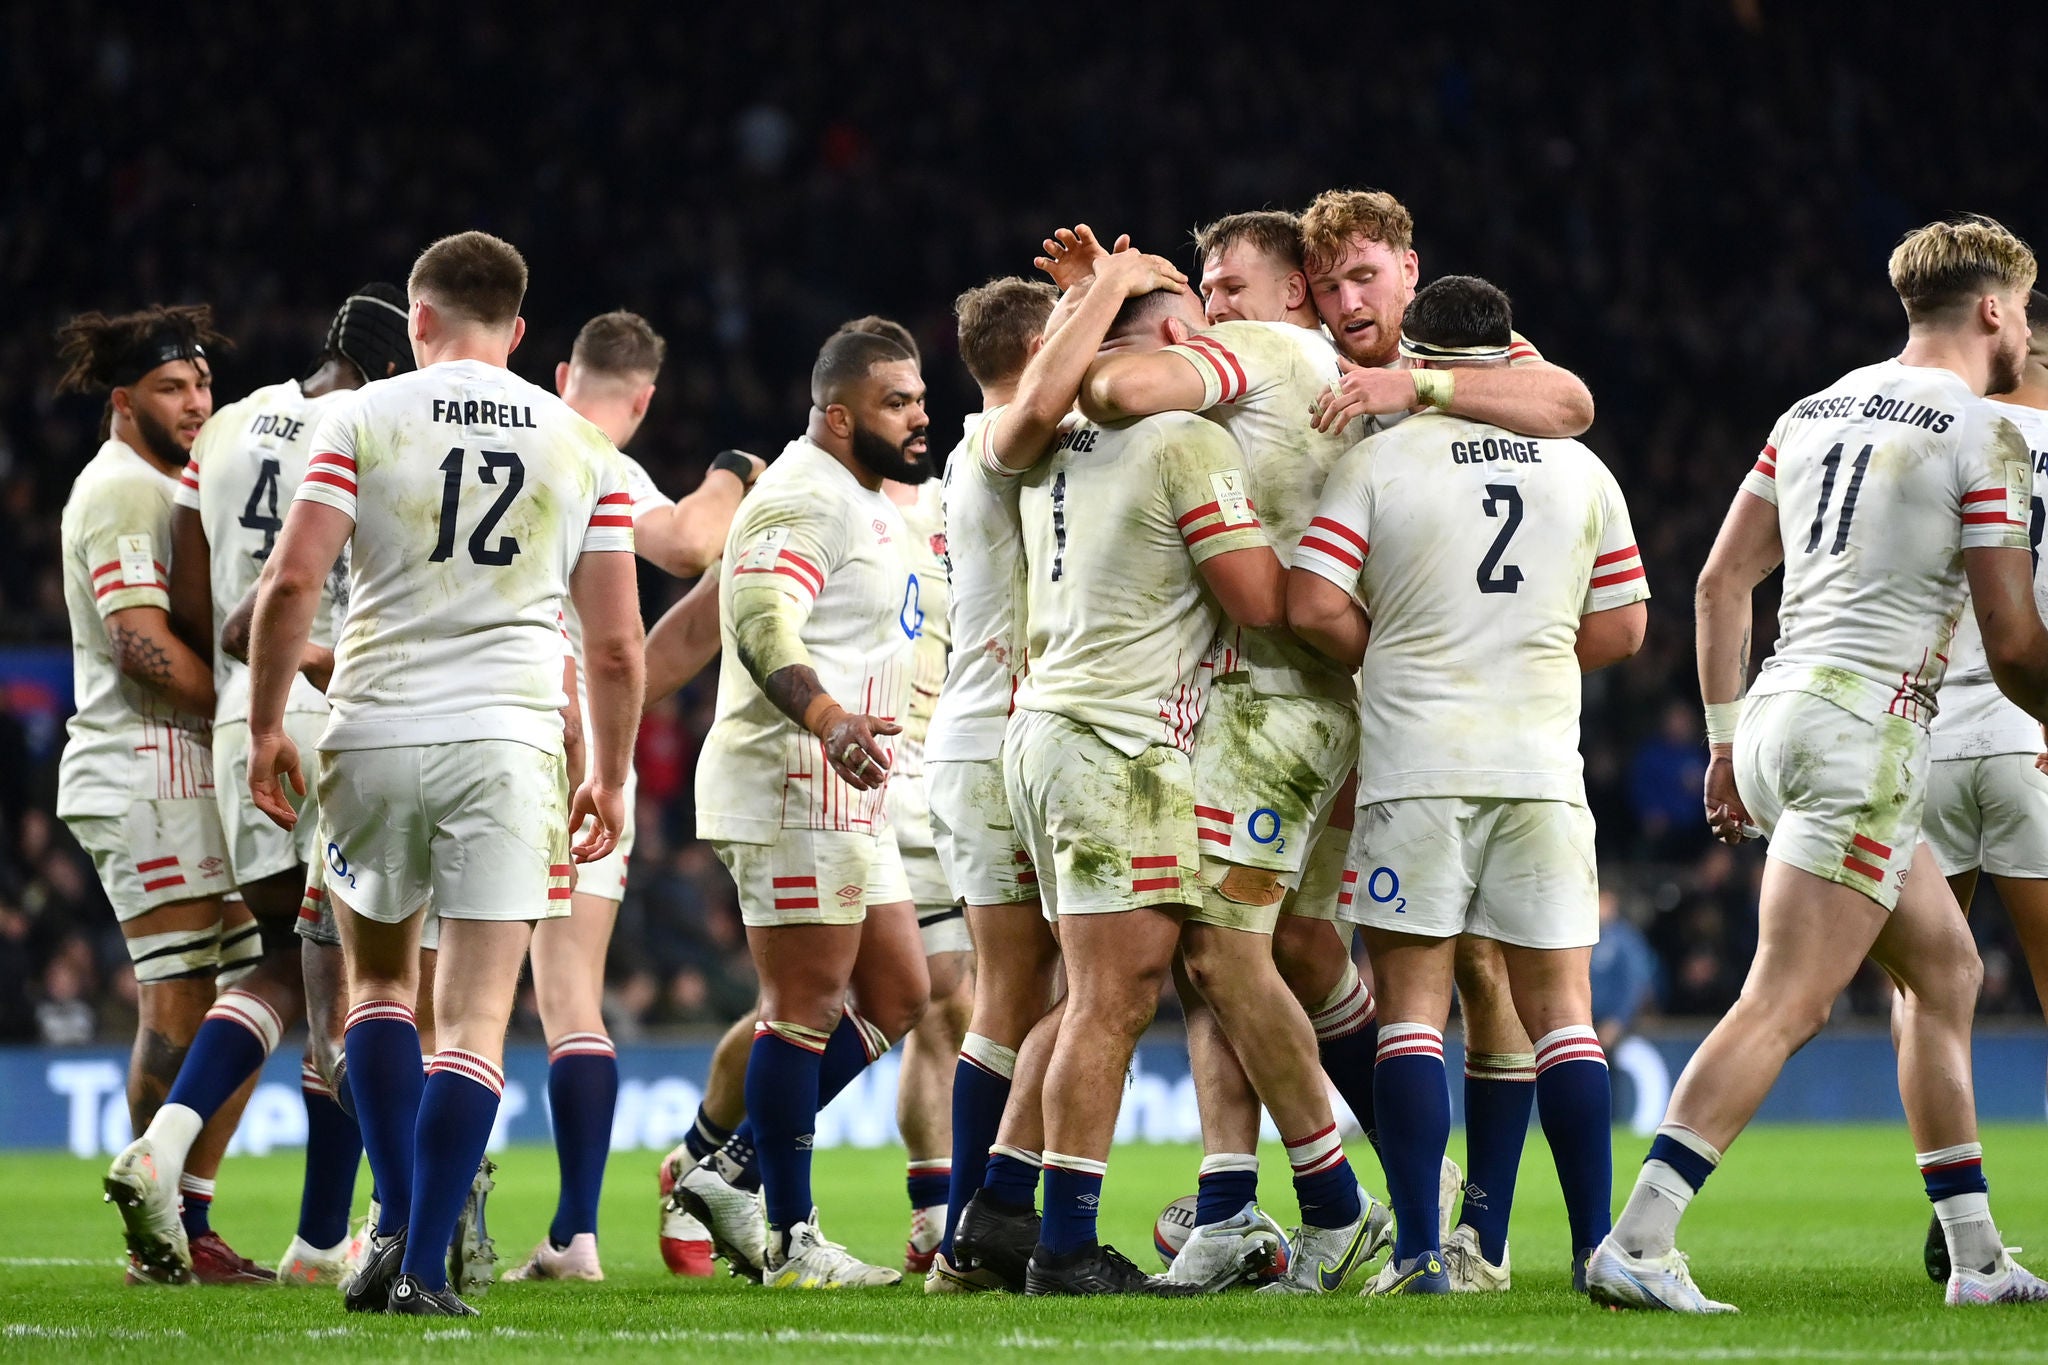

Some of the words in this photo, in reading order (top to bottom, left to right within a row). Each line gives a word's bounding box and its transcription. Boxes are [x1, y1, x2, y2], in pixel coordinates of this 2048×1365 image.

[432, 399, 537, 429] FARRELL
[1792, 394, 1955, 434] HASSEL-COLLINS
[1451, 438, 1542, 465] GEORGE
[238, 459, 283, 560] 4
[428, 447, 526, 567] 12
[1804, 442, 1874, 556] 11
[1051, 471, 1067, 582] 1
[1476, 484, 1525, 594] 2
[1247, 807, 1285, 854] O2
[327, 842, 357, 890] O2
[1368, 866, 1407, 914] O2
[1161, 1205, 1196, 1230] GIL
